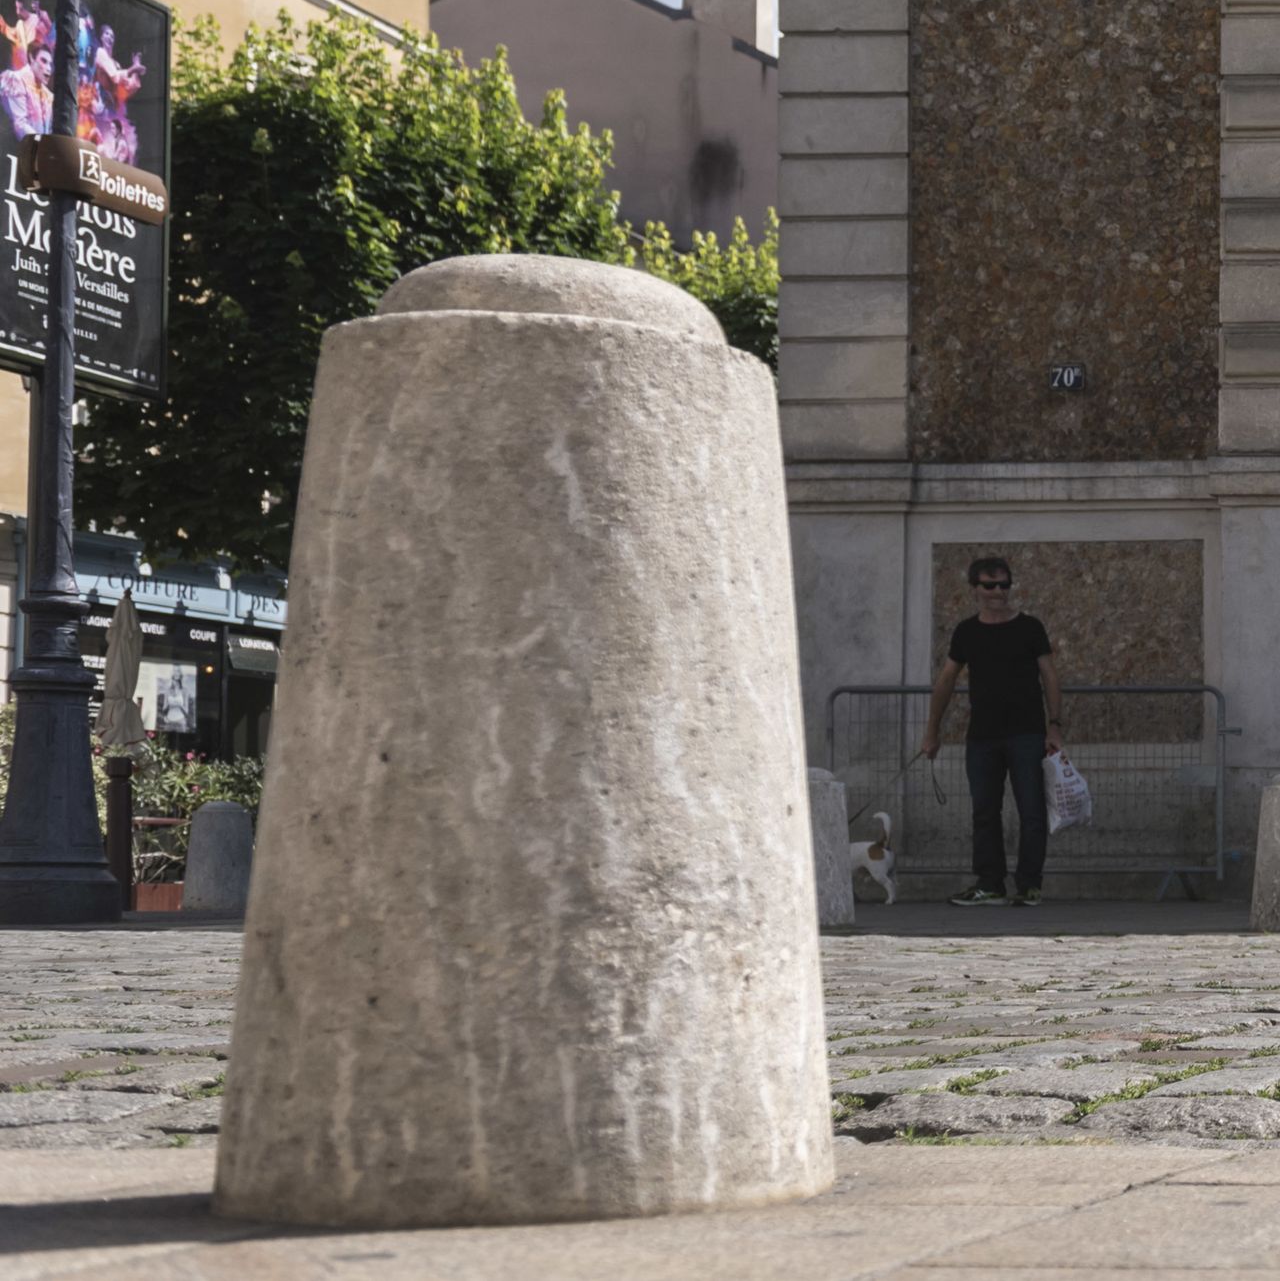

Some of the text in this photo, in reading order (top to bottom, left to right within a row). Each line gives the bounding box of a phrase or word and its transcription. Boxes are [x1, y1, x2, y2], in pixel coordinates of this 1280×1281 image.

[100, 170, 165, 212] Toilettes
[4, 199, 136, 283] Mière
[11, 248, 42, 274] Juin
[76, 271, 130, 304] Versailles
[108, 573, 199, 601] COIFFURE
[189, 629, 217, 643] COUPE
